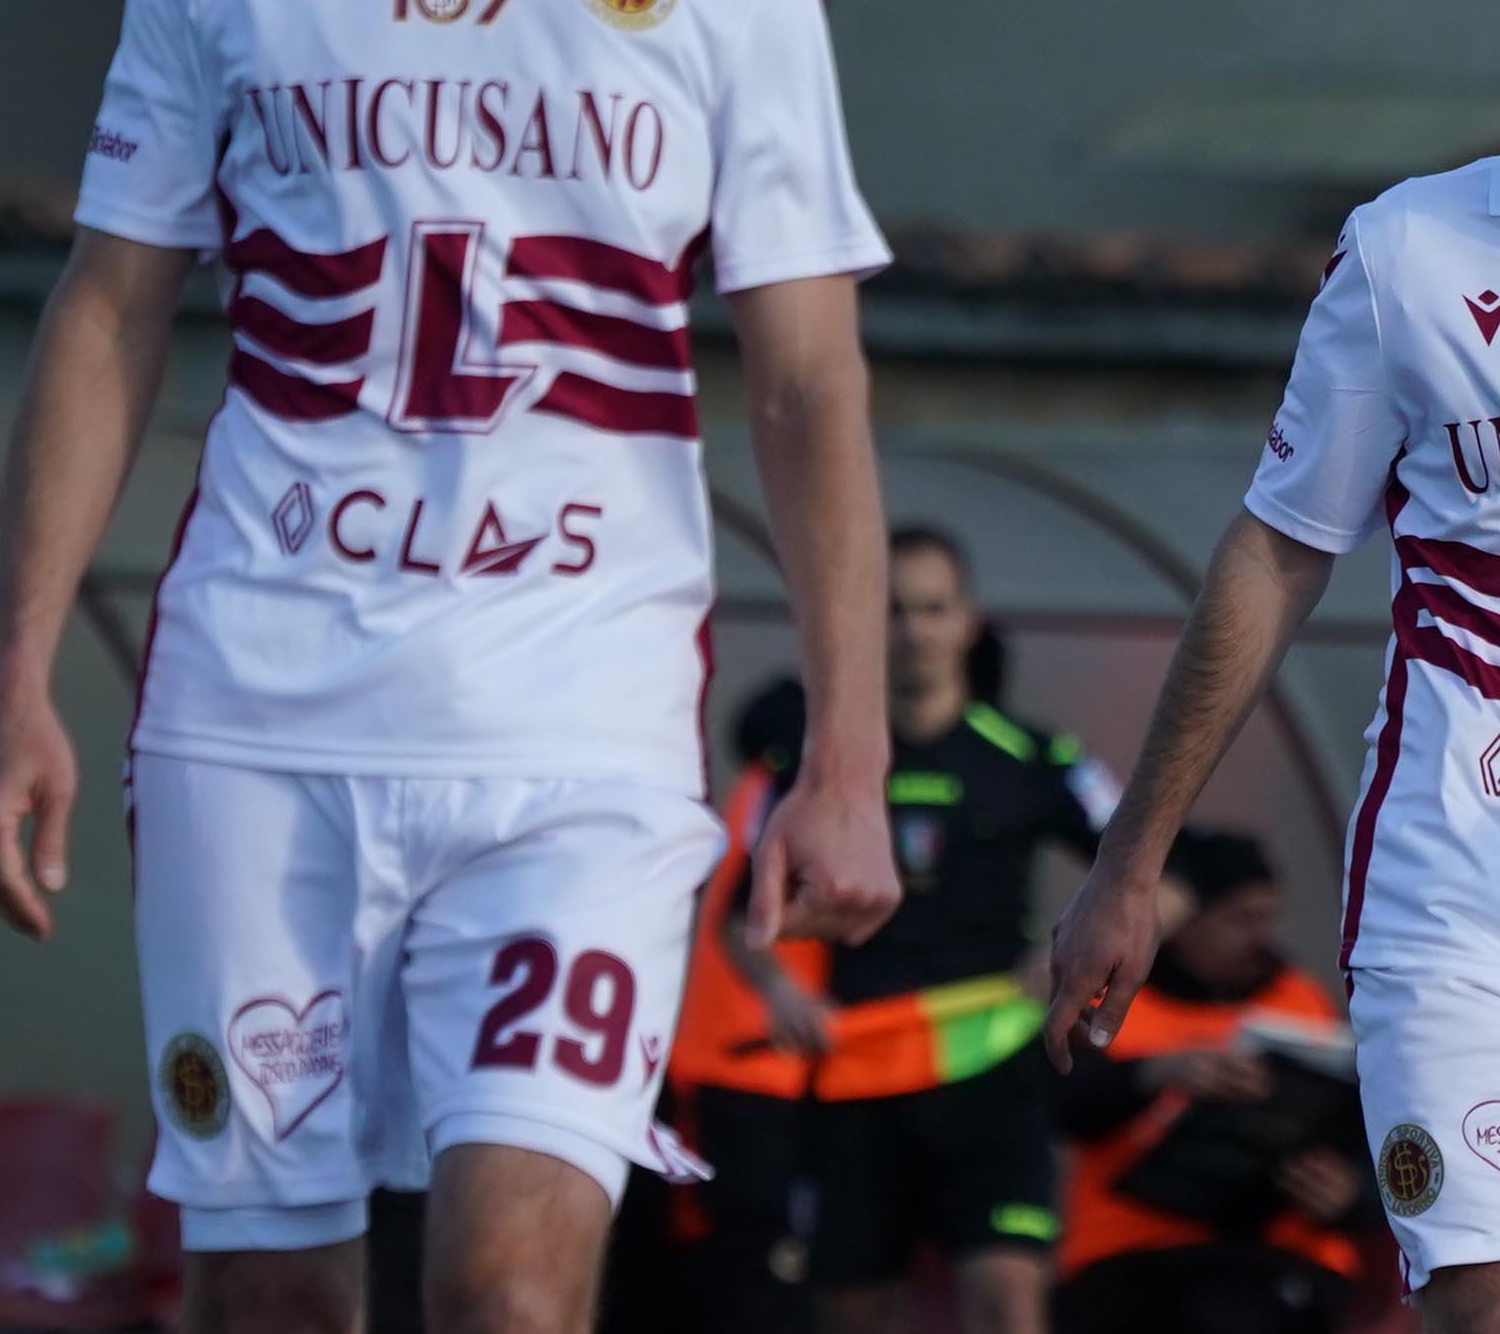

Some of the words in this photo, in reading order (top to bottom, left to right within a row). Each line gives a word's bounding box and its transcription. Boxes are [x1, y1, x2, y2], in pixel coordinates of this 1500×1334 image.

[246, 77, 665, 193] UNICUSANO
[327, 490, 604, 578] CLAS
[470, 933, 637, 1090] 29
